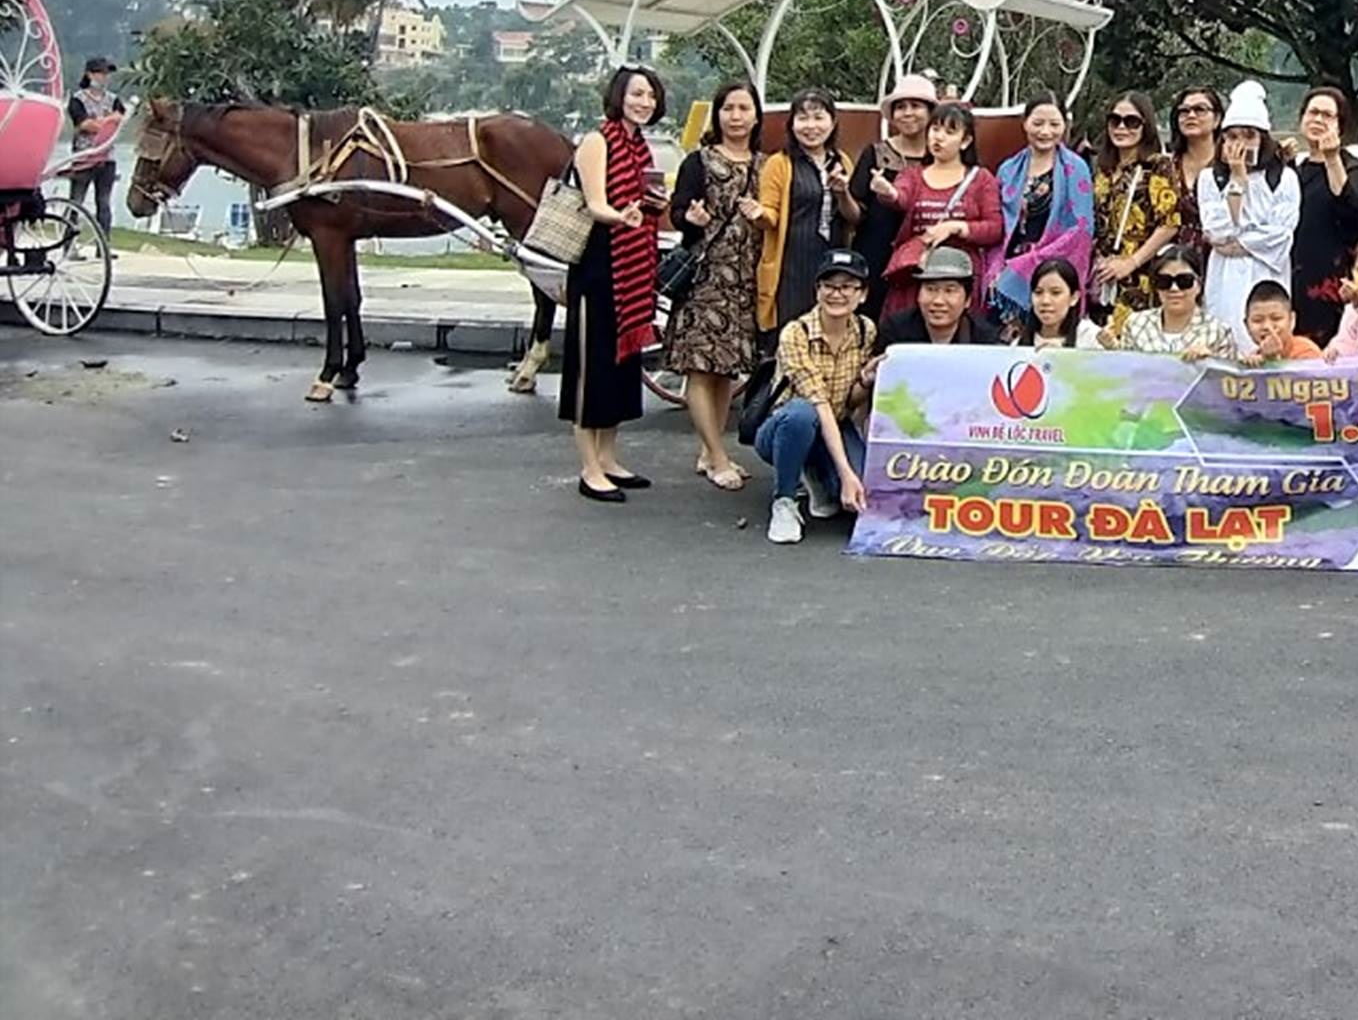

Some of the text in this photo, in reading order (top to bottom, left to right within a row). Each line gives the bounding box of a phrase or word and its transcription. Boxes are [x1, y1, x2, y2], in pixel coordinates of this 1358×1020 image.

[1221, 376, 1257, 402] 02
[886, 451, 1347, 496] Chào Đón Đoàn Tham Gia
[925, 495, 1291, 551] TOUR ĐÀ LẠT
